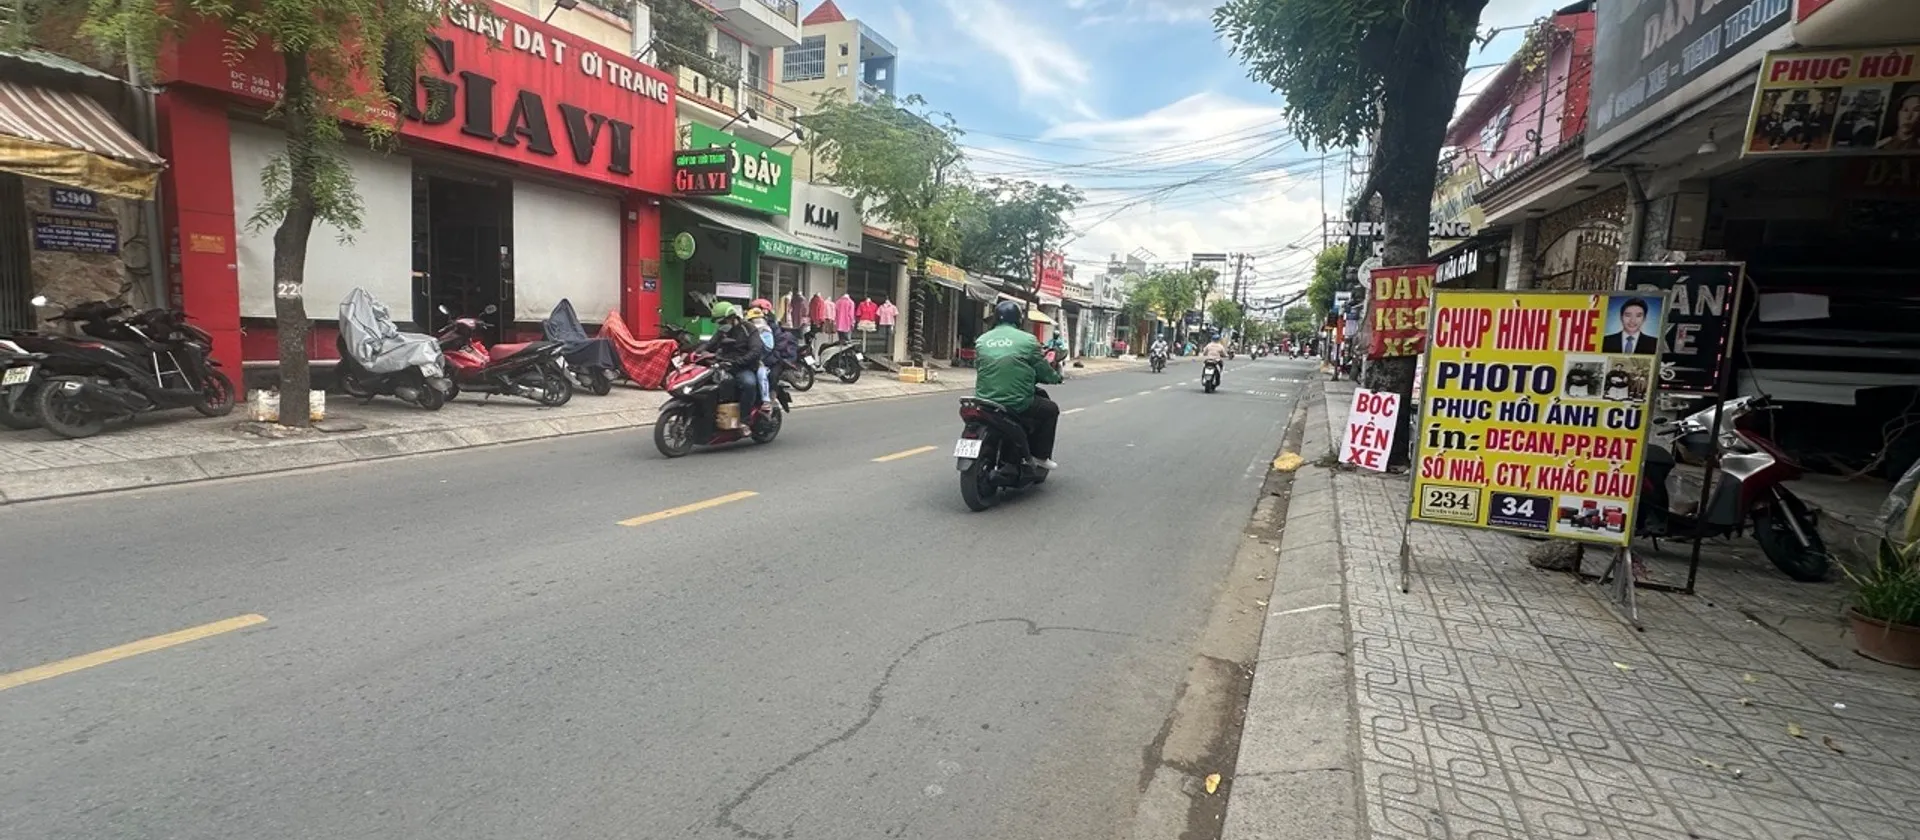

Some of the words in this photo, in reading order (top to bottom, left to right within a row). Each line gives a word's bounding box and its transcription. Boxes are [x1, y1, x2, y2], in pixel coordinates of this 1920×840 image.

[513, 22, 548, 59] DA
[606, 60, 669, 105] TRANG
[1770, 57, 1851, 84] PHỤC
[1858, 48, 1915, 78] HỒI
[55, 190, 93, 206] 590
[1375, 269, 1435, 300] DÁN
[1375, 306, 1430, 331] KEO
[1435, 307, 1493, 358] CHỤP
[1496, 299, 1552, 351] HÌNH
[1558, 294, 1601, 352] THẺ
[986, 337, 1013, 348] Grab
[1383, 336, 1421, 357] XE
[1436, 361, 1558, 395] PHOTO
[1432, 397, 1493, 424] PHỤC
[1500, 395, 1540, 423] HỒI
[1547, 397, 1599, 427] ẢNH
[1606, 404, 1642, 430] CŨ
[1350, 422, 1390, 451] YÊN
[1347, 447, 1382, 468] XE
[1422, 450, 1446, 480] SỐ
[1450, 456, 1490, 487] NHÀ,
[1496, 463, 1531, 491] CTY,
[1537, 460, 1589, 493] KHẮC
[1594, 465, 1636, 498] DẤU
[1429, 490, 1471, 510] 234
[1501, 497, 1534, 518] 34
